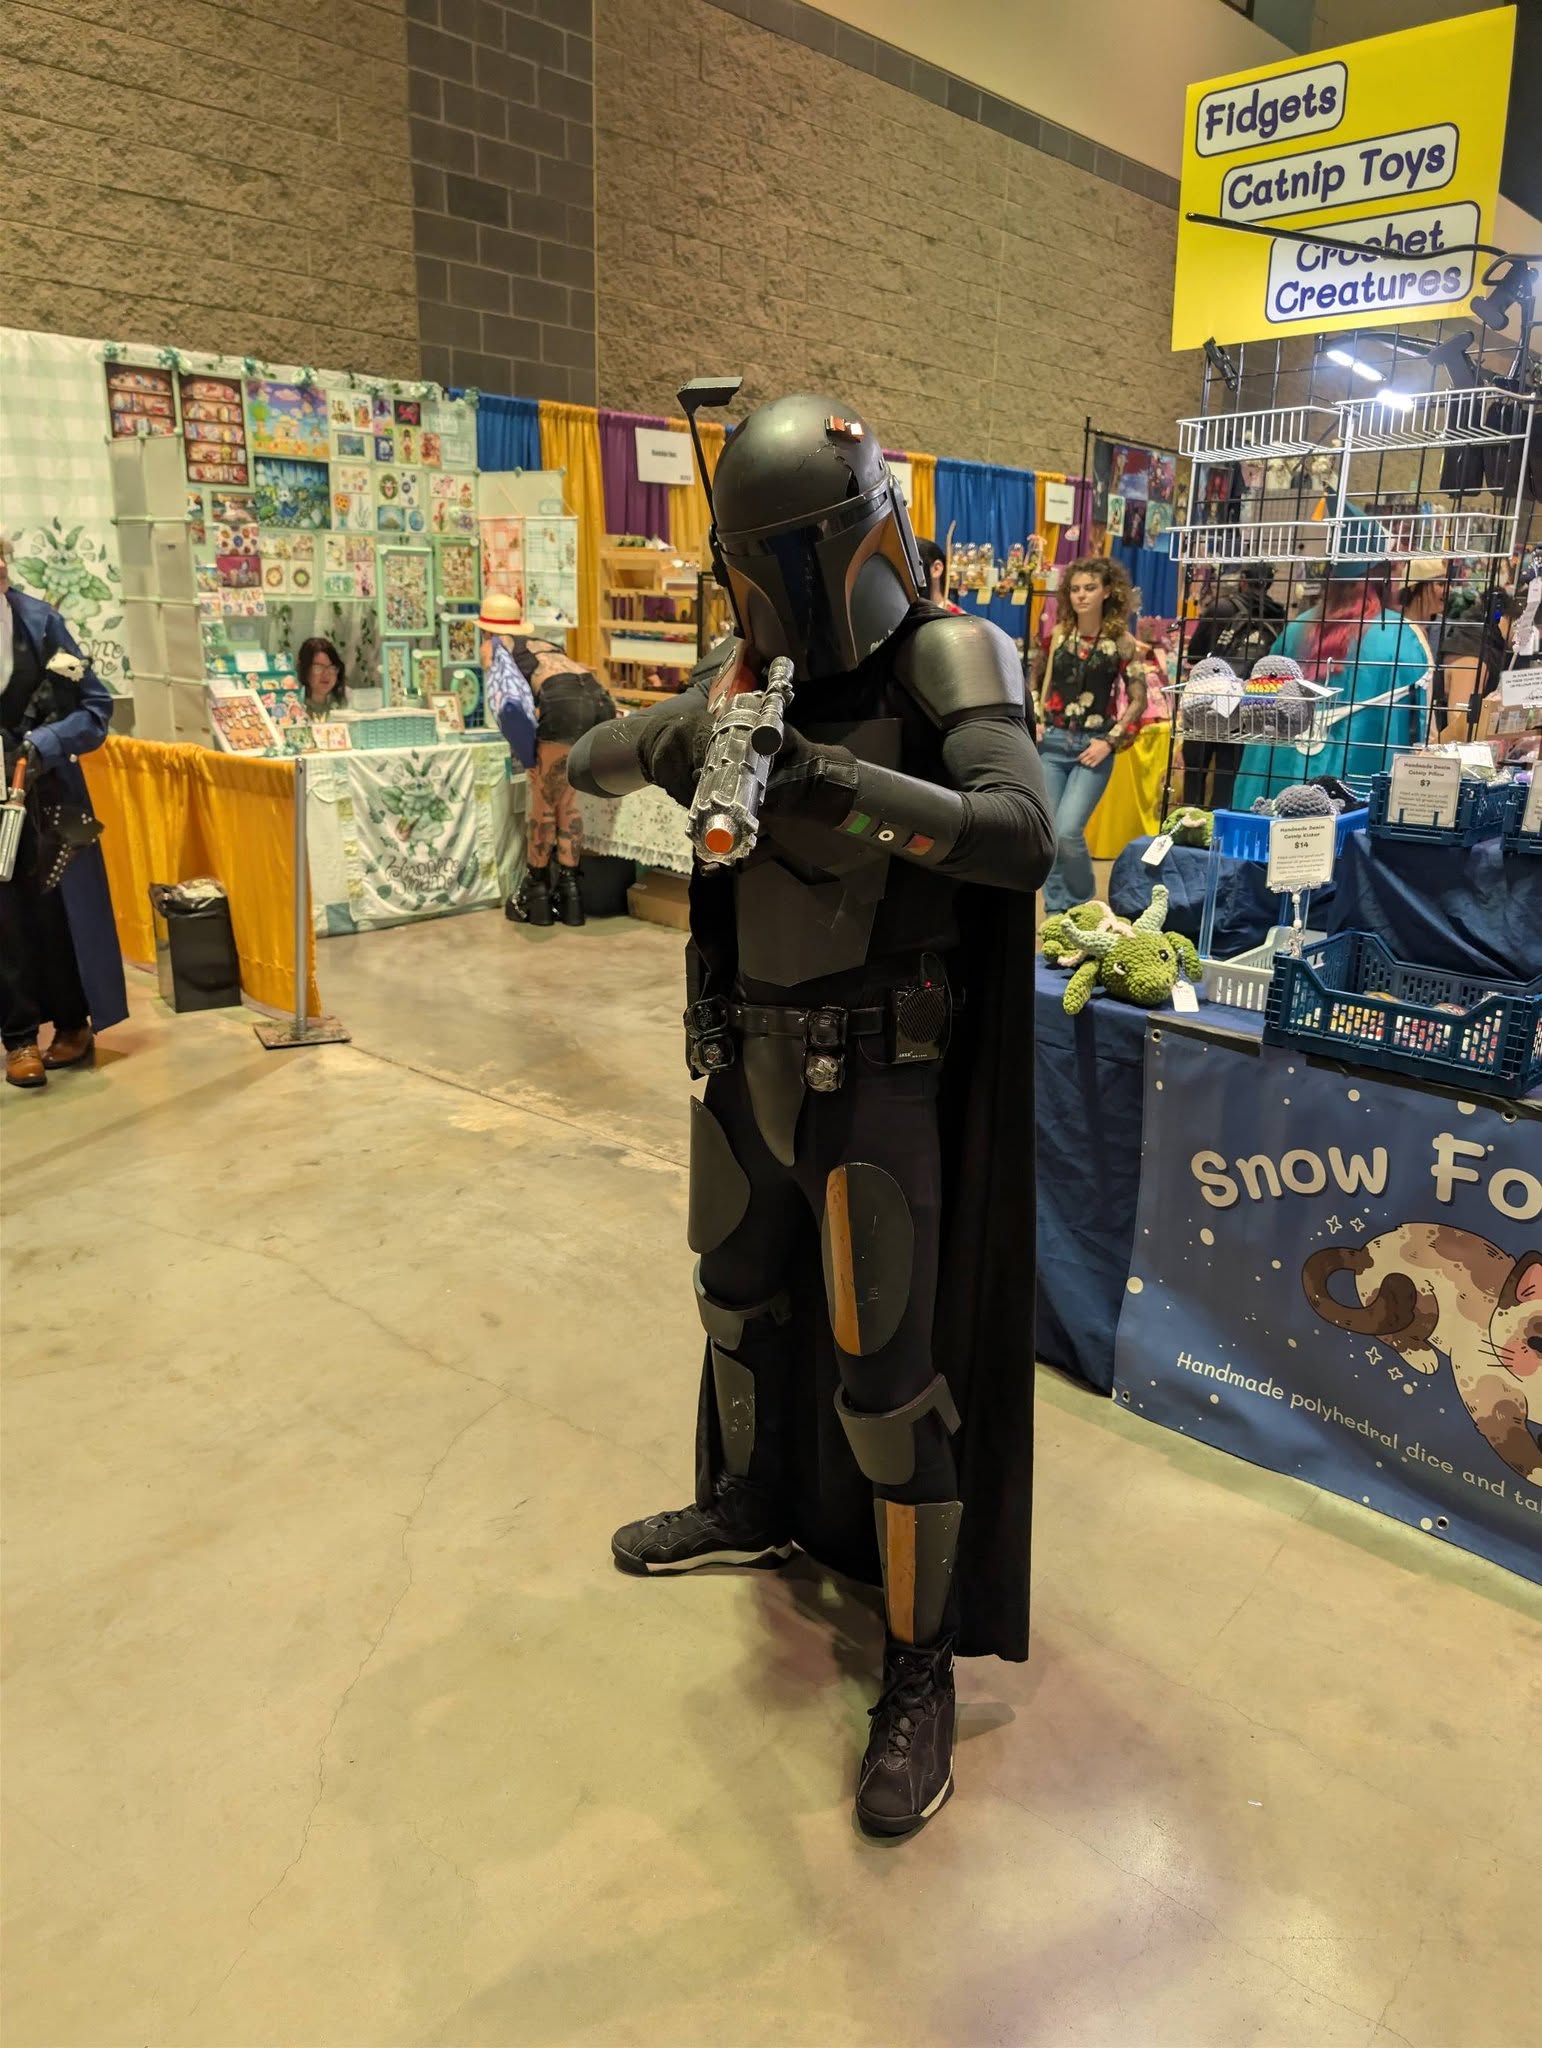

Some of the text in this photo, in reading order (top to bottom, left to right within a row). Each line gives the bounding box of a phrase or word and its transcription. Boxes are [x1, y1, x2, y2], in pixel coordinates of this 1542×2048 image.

[1205, 83, 1337, 140] Fidgets
[1228, 144, 1446, 209] Catnip Toys
[1275, 266, 1462, 314] Creatures
[1294, 841, 1309, 849] $14
[1191, 1146, 1387, 1208] Snow
[1176, 1351, 1542, 1514] Handmade polyhedral dice and ta
